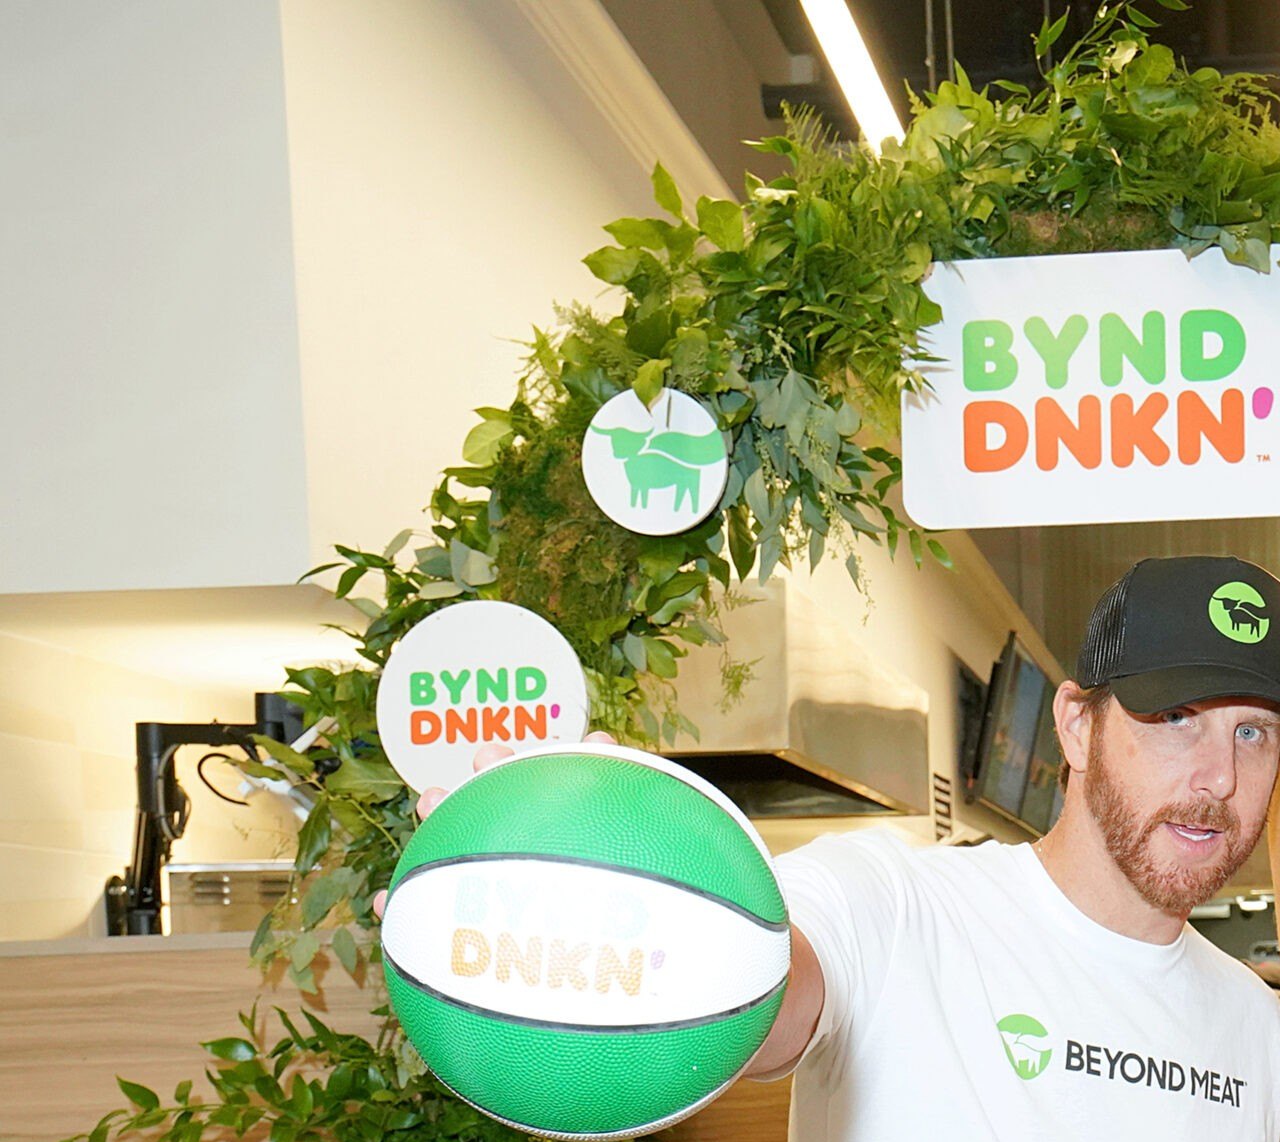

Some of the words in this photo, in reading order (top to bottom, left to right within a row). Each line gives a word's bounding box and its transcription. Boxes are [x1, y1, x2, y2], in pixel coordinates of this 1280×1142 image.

[962, 309, 1247, 392] BYND
[963, 387, 1274, 473] DNKN'
[410, 666, 547, 706] BYND
[410, 704, 560, 745] DNKN'
[451, 927, 667, 997] DNKN'
[1065, 1040, 1186, 1092] BEYOND
[1190, 1066, 1245, 1108] MEAT
